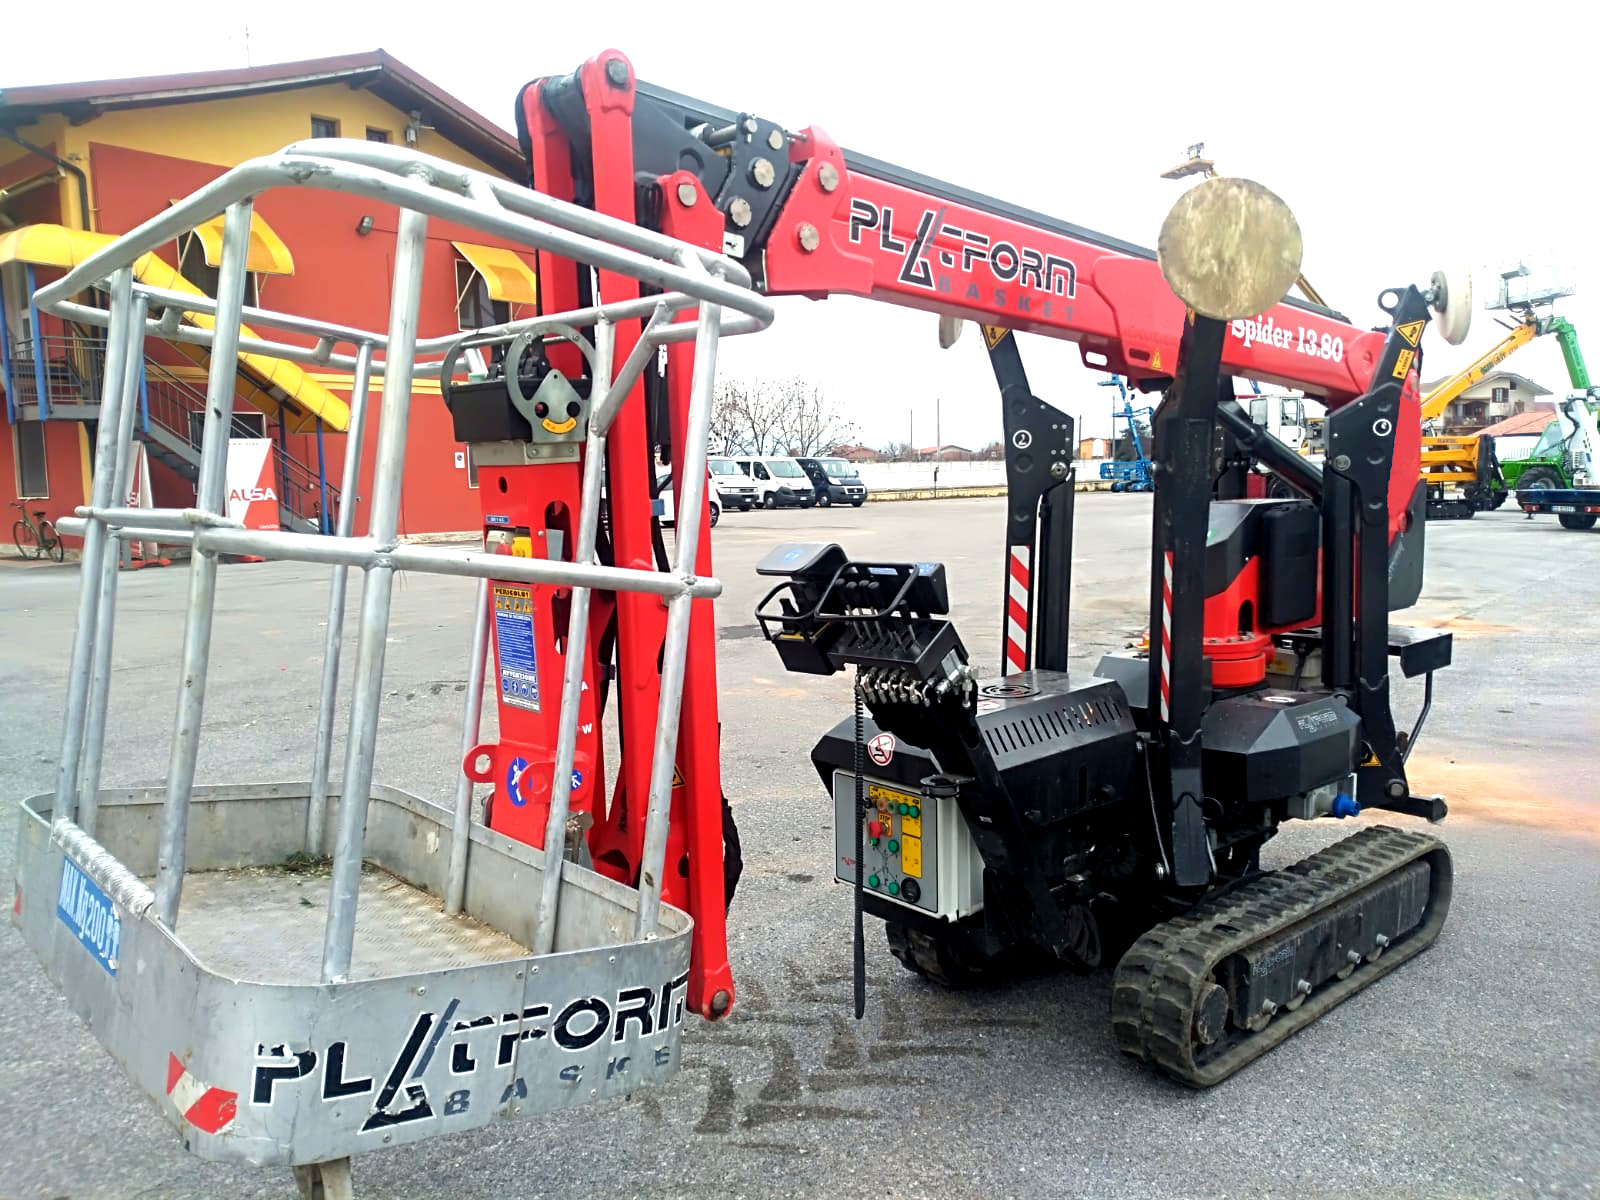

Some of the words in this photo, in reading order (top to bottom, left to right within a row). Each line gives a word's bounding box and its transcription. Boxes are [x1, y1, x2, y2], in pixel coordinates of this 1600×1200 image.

[849, 197, 1076, 299] PLATFORM
[938, 275, 1075, 323] BASKET
[1231, 315, 1292, 348] Spider
[1296, 326, 1343, 362] 13.80
